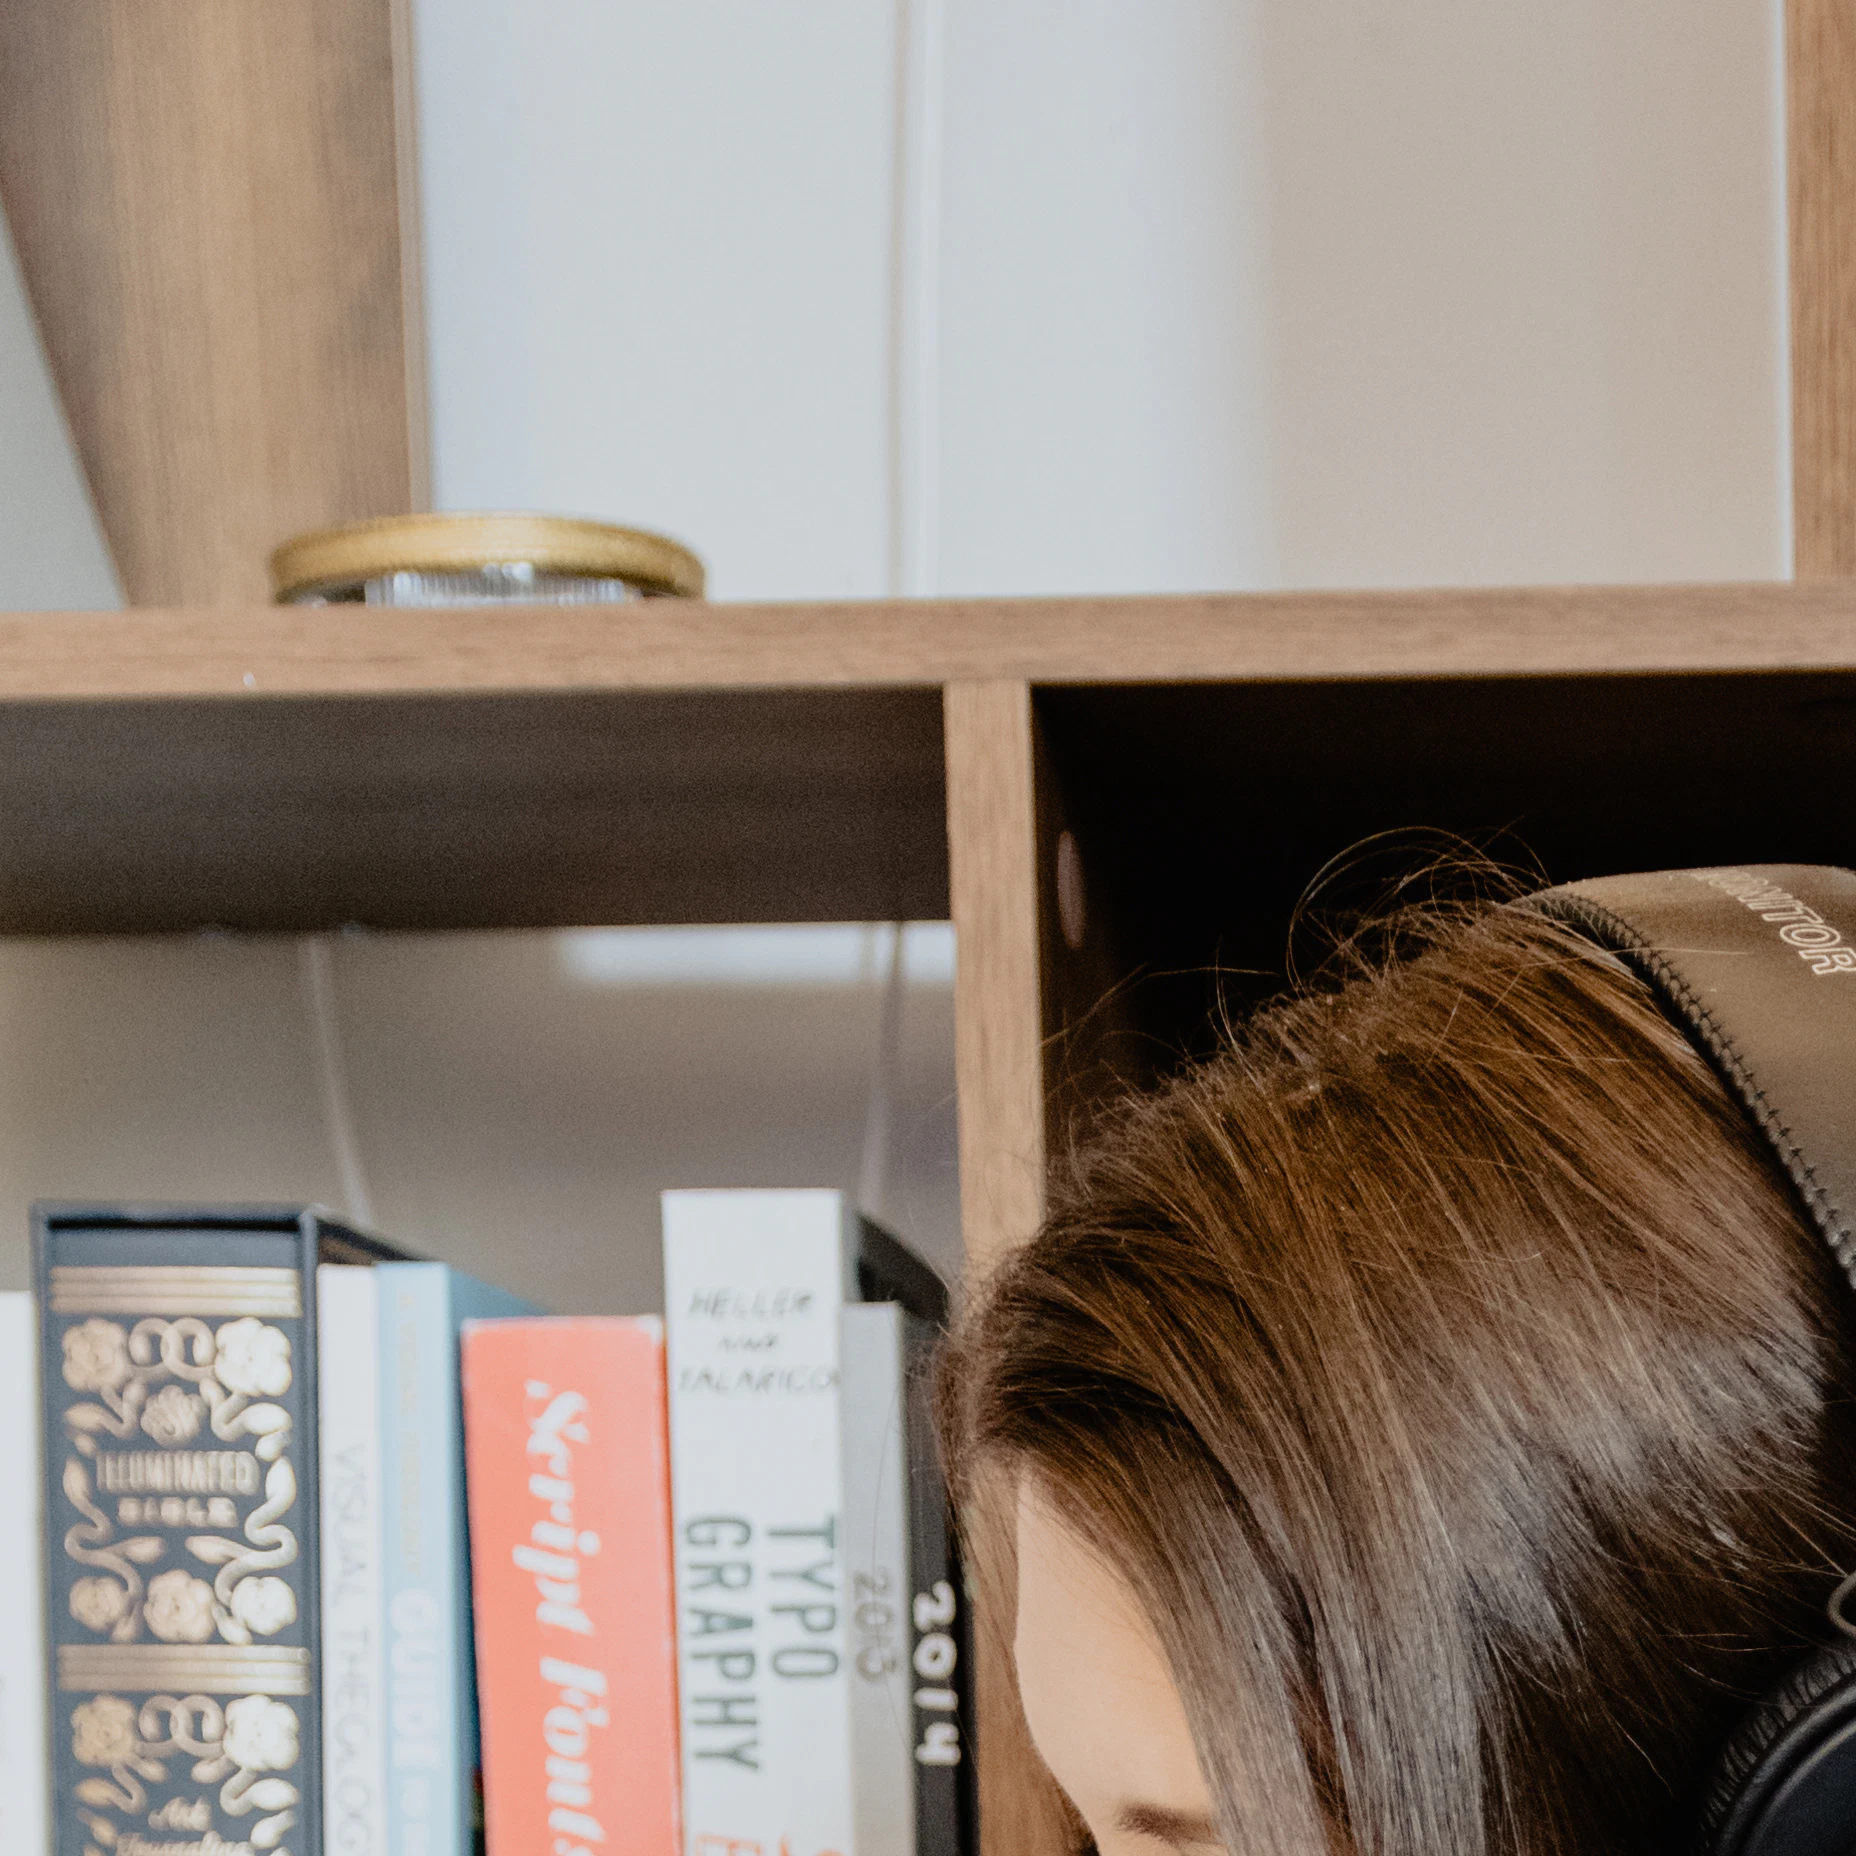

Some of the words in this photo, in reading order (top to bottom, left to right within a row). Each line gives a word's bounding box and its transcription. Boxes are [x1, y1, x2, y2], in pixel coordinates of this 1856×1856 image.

[511, 1378, 602, 1637] Script
[767, 1515, 840, 1680] TYPO
[686, 1515, 761, 1773] GRAPHY
[912, 1579, 962, 1767] 2014
